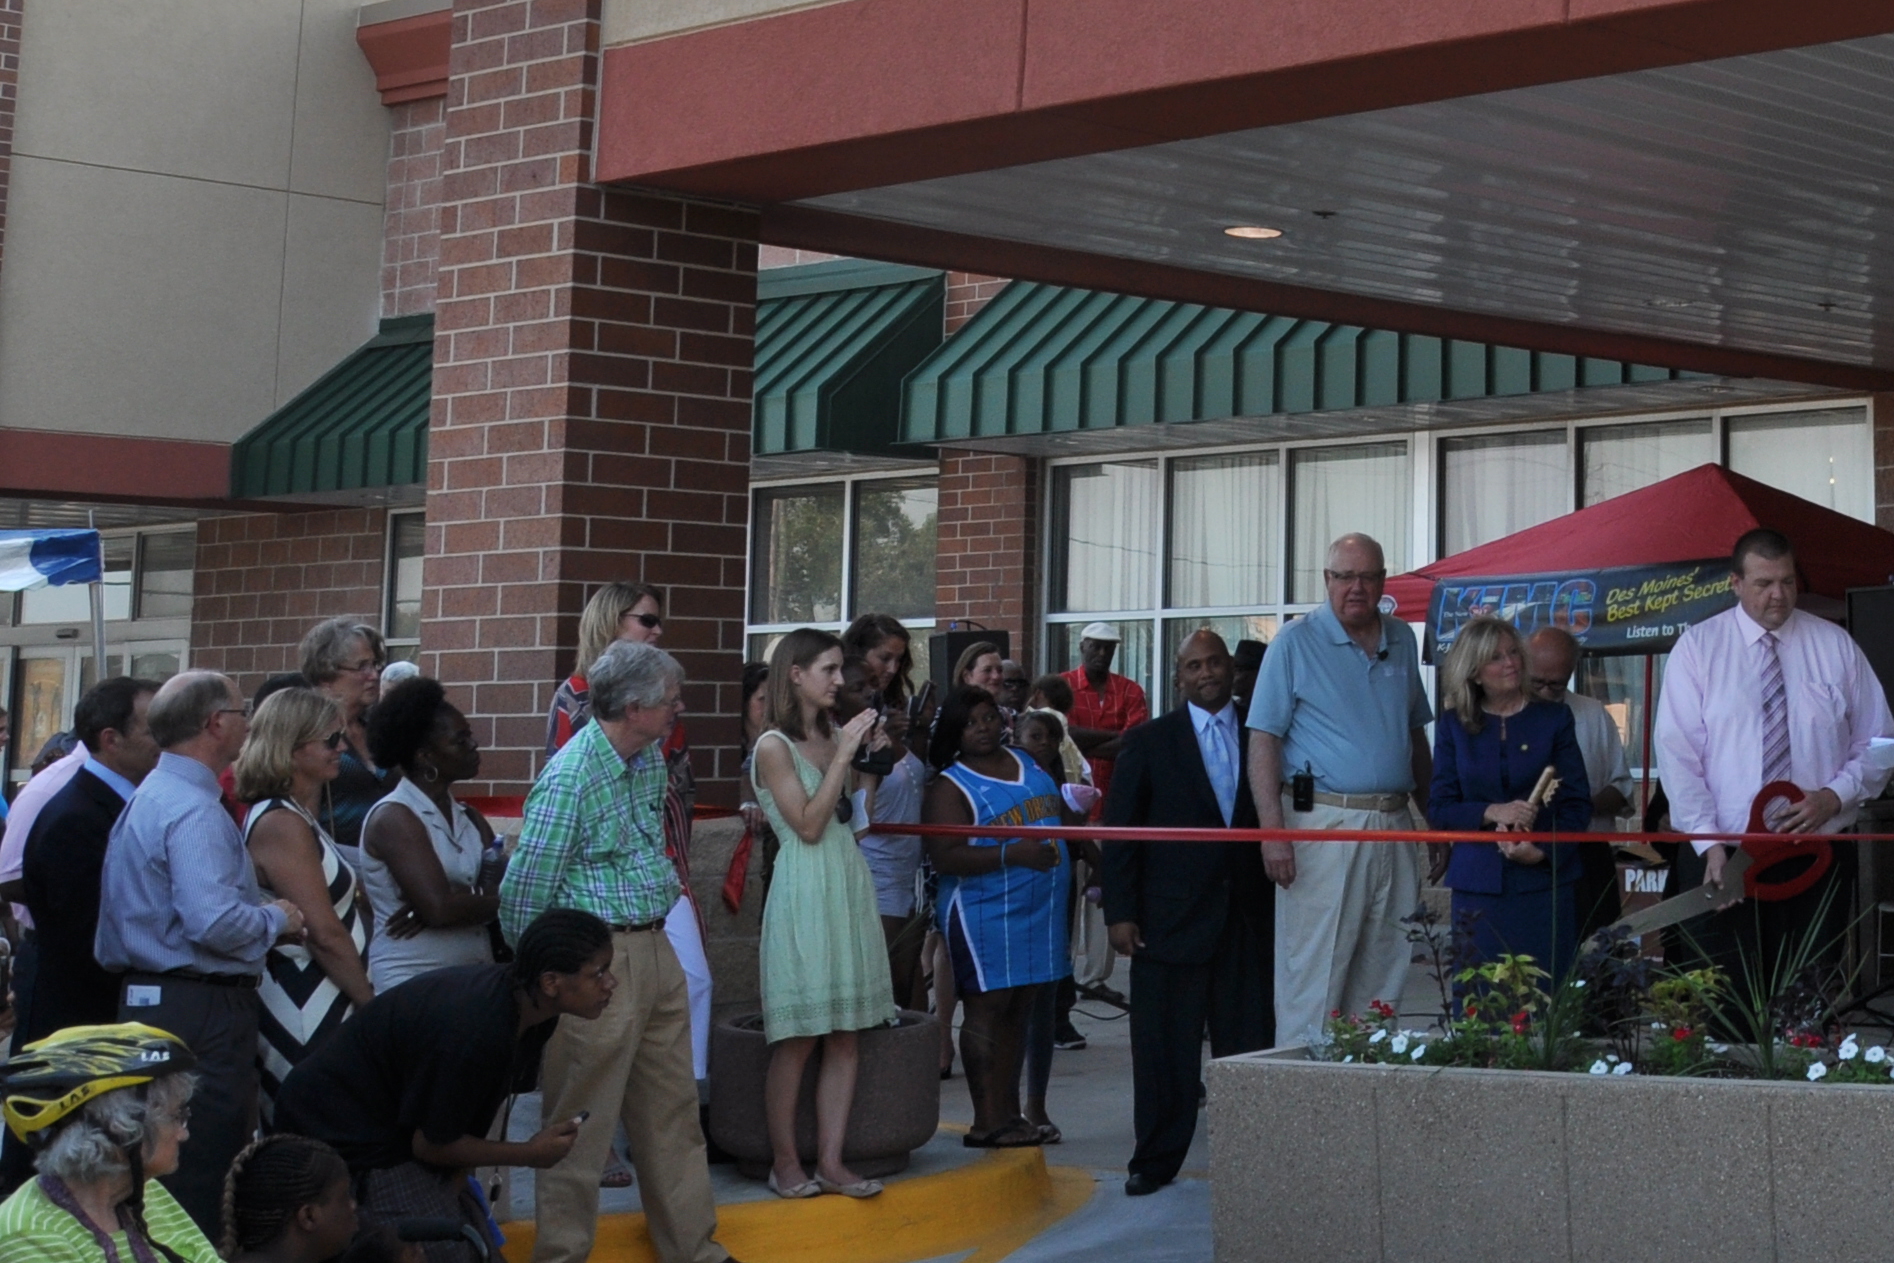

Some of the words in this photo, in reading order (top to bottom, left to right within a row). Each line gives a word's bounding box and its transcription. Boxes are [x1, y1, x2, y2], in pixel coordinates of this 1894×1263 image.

[1605, 586, 1635, 605] Des
[1637, 566, 1700, 597] Moines'
[1606, 599, 1641, 623] Best
[1644, 590, 1679, 614] Kept
[1626, 625, 1658, 640] Listen
[1661, 624, 1674, 636] to
[140, 1051, 170, 1062] LAS
[59, 1086, 91, 1110] LAS
